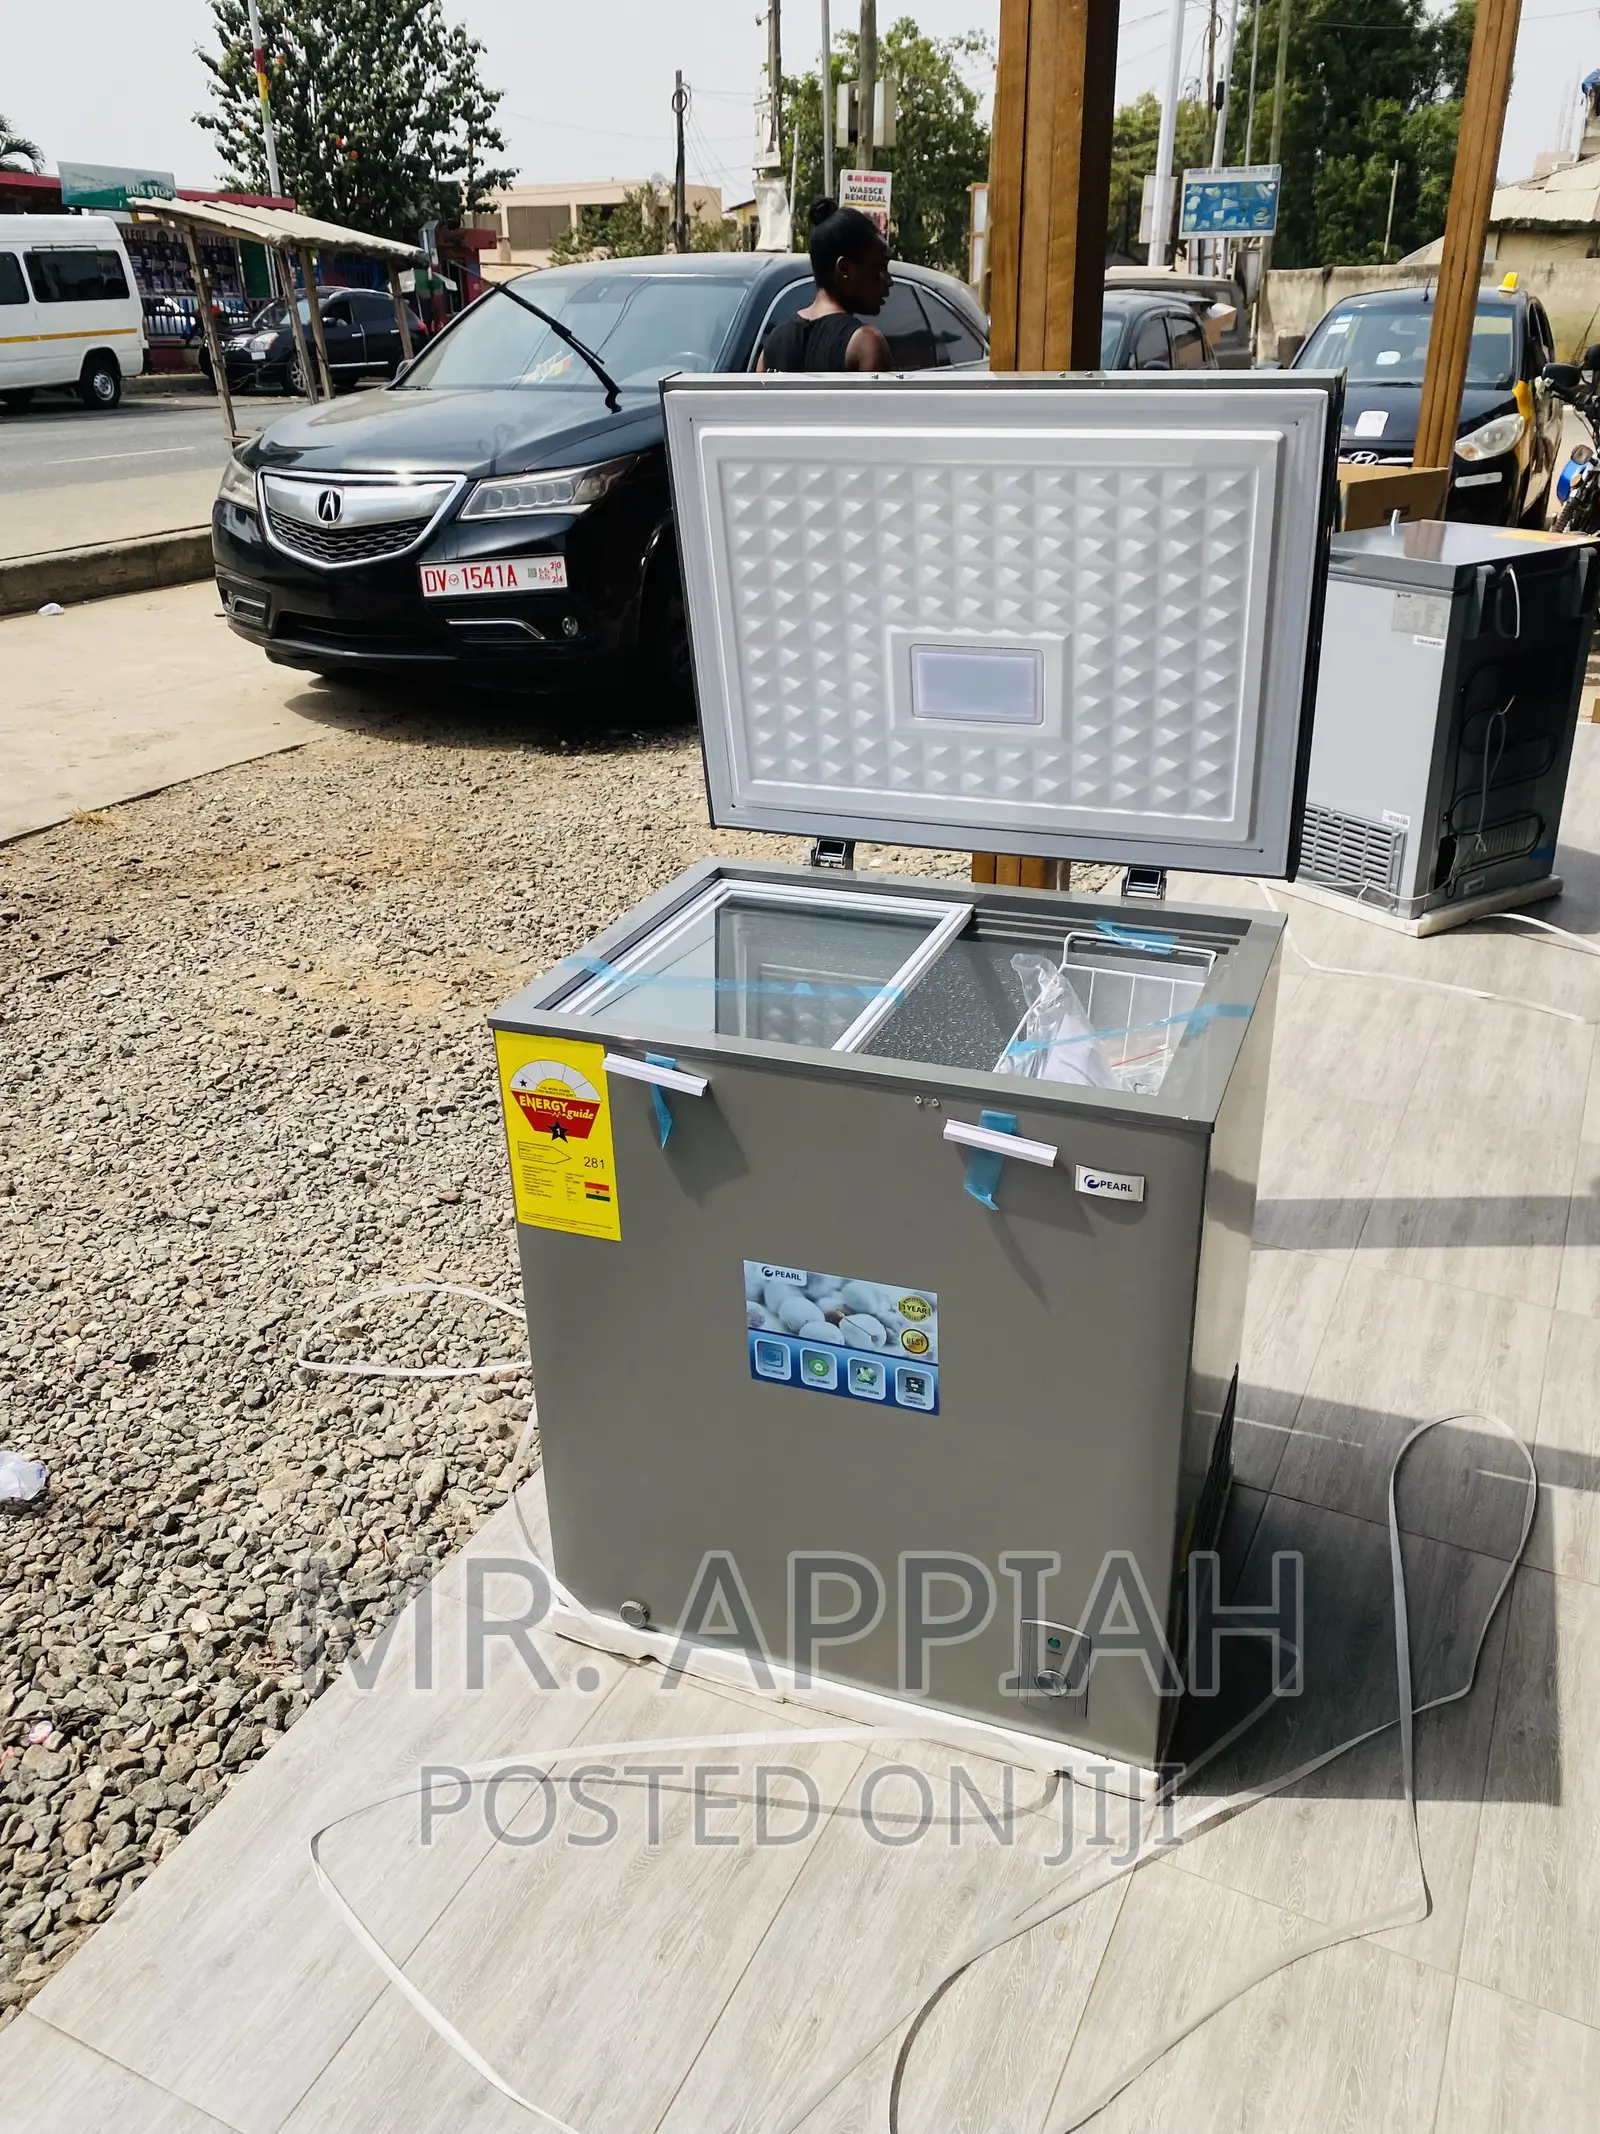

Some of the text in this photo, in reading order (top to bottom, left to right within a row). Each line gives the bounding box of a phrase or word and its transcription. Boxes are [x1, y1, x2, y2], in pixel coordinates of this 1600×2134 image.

[125, 184, 145, 196] BUS
[849, 185, 883, 194] WASSCE
[845, 193, 887, 202] REMEDIAL
[424, 564, 517, 592] DV 1541A
[519, 1093, 568, 1112] ENERGY
[566, 1108, 594, 1120] guide
[556, 1128, 561, 1136] 1
[584, 1156, 604, 1169] 281
[1100, 1180, 1133, 1192] PEARL
[775, 1270, 801, 1281] PEARL
[907, 1305, 927, 1314] YEAR
[907, 1337, 925, 1347] BEST
